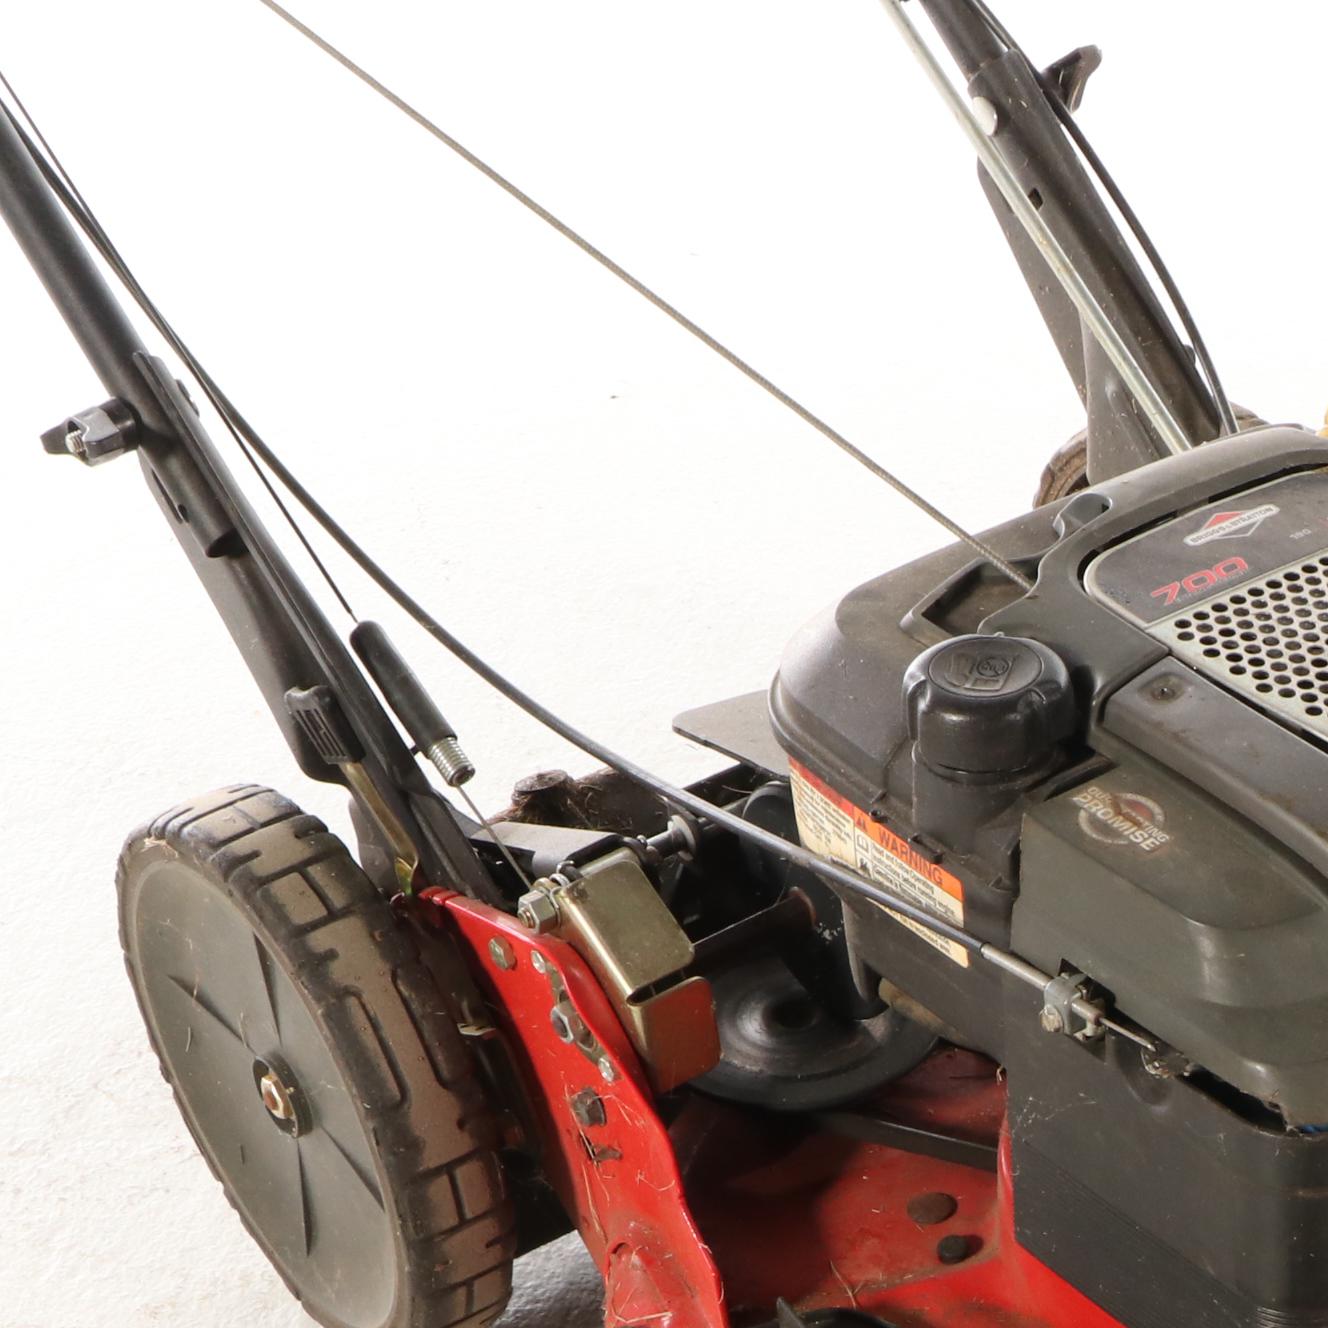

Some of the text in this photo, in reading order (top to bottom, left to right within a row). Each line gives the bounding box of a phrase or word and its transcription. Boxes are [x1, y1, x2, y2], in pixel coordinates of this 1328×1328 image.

[1151, 556, 1249, 606] 700
[1072, 793, 1160, 851] PROMISE
[880, 830, 943, 886] WARNING
